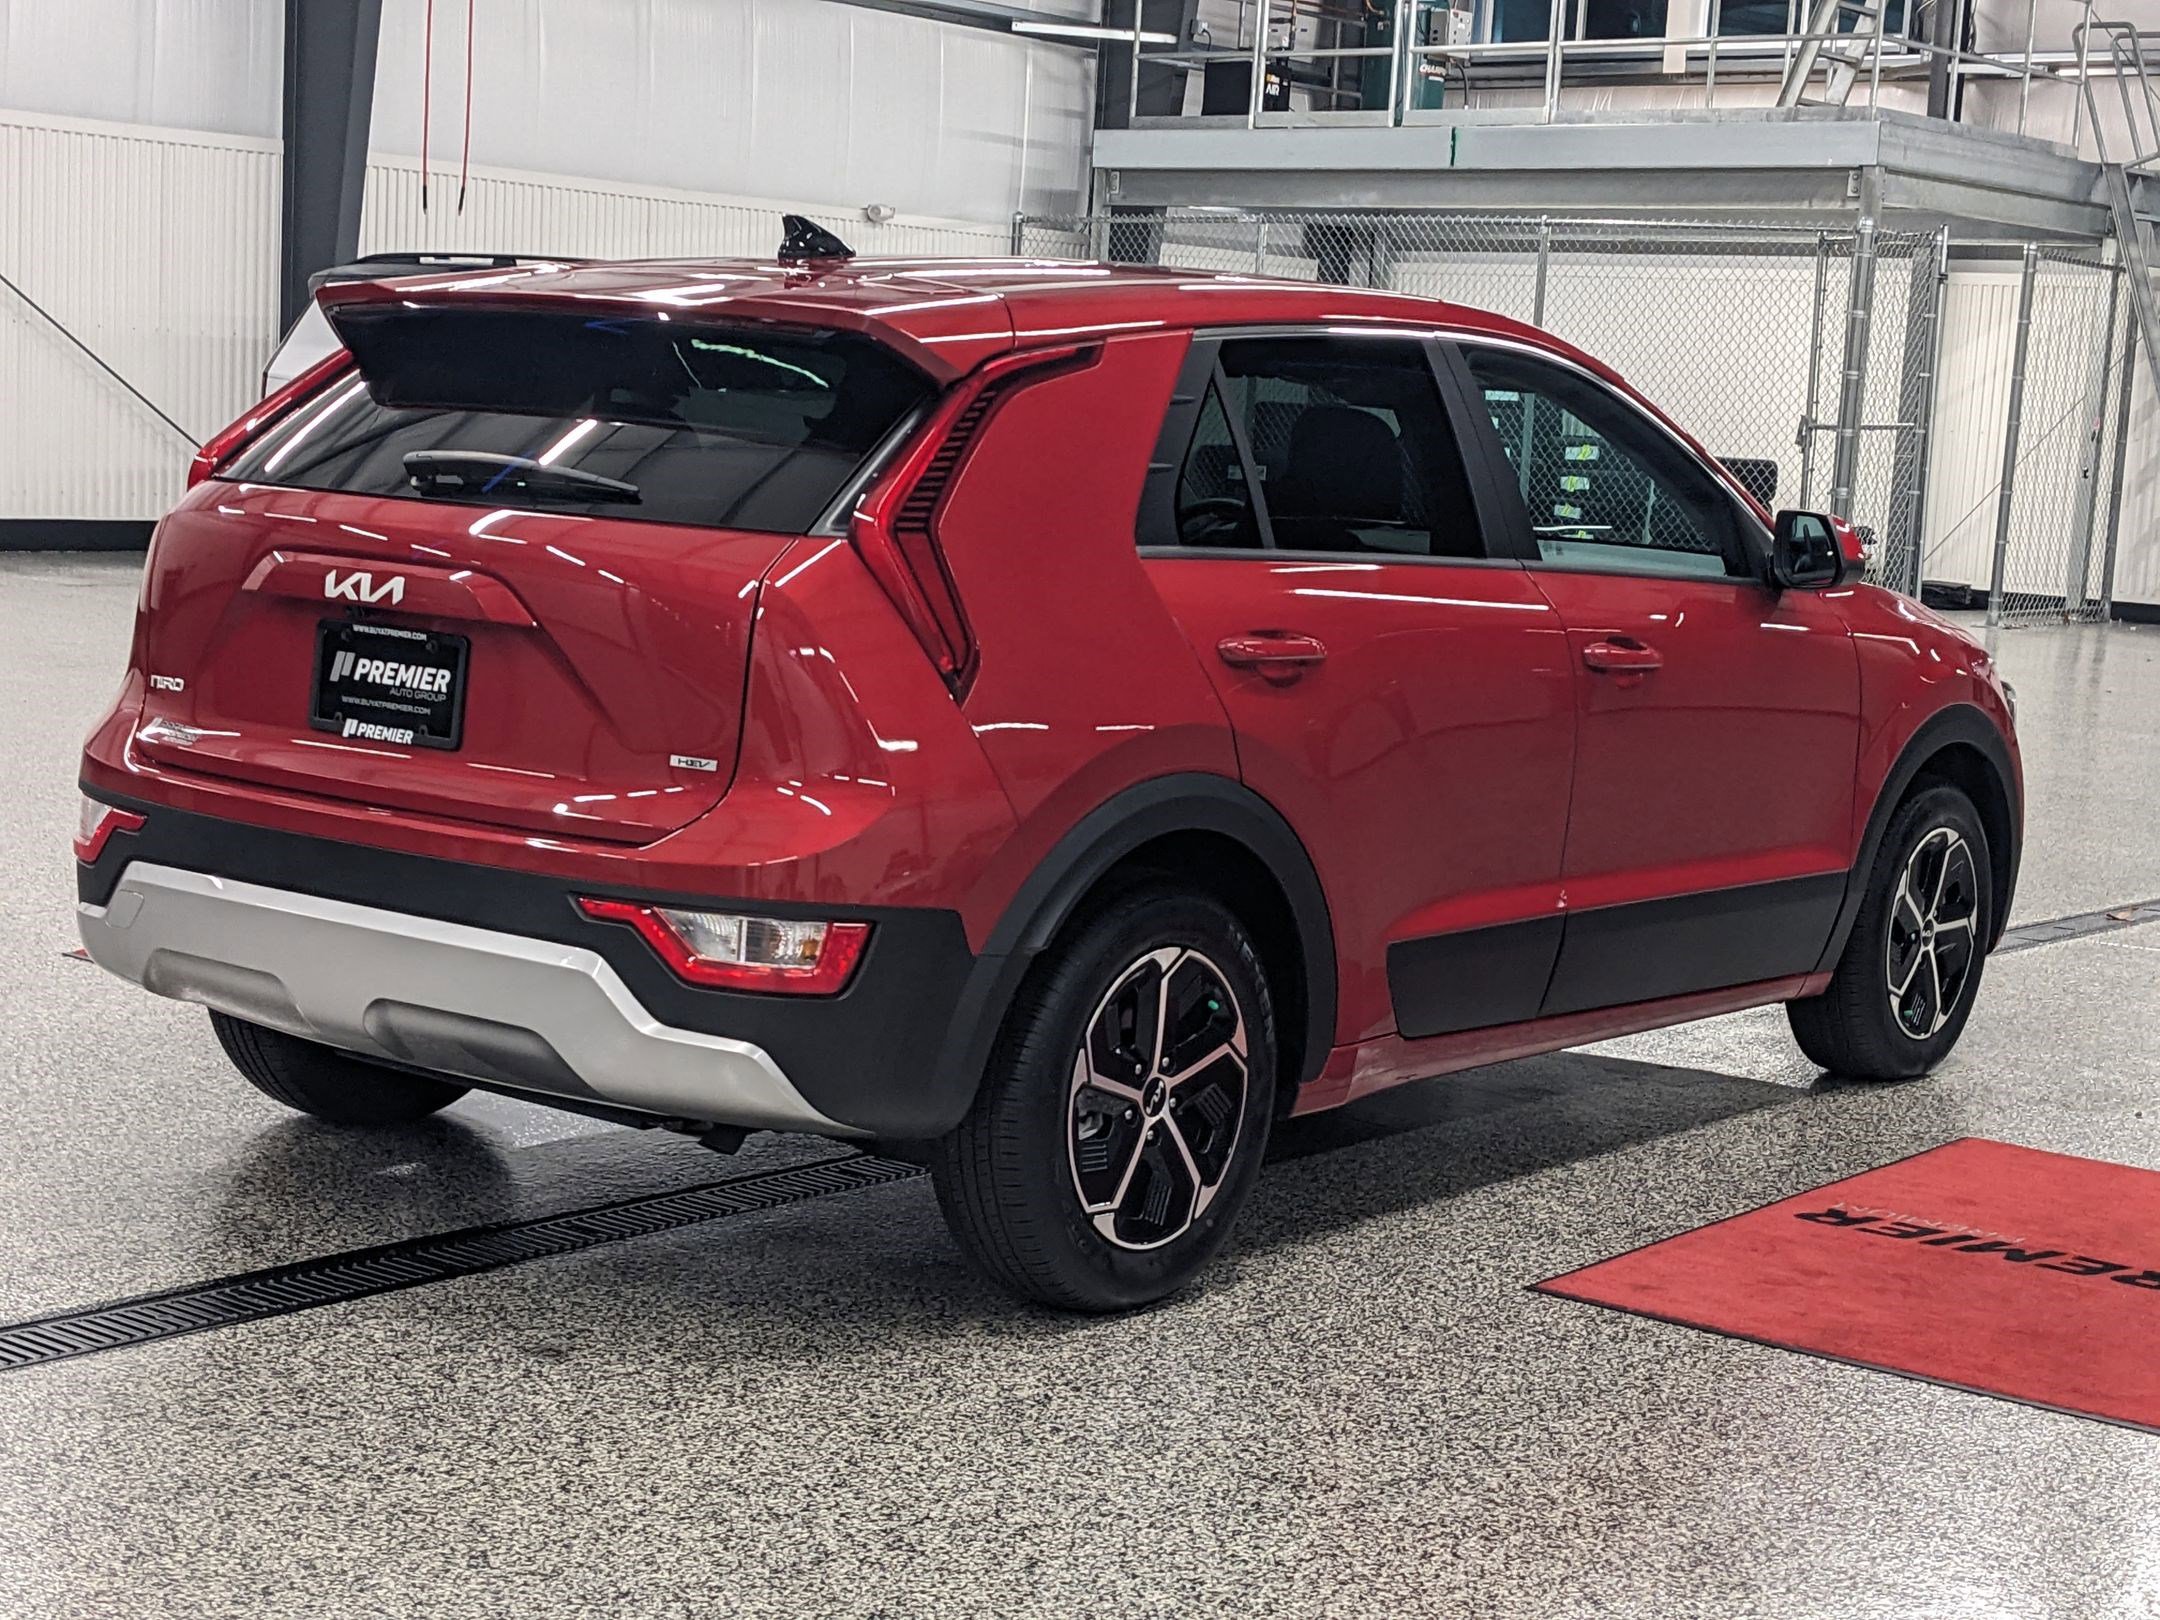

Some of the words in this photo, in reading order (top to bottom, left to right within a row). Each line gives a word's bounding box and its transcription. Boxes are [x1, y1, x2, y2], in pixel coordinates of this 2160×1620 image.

[324, 569, 405, 605] KIA
[150, 674, 185, 692] NIRO
[353, 658, 452, 693] PREMIER
[389, 687, 413, 699] AUTO
[414, 690, 447, 702] GROUP
[357, 724, 414, 745] PREMIER
